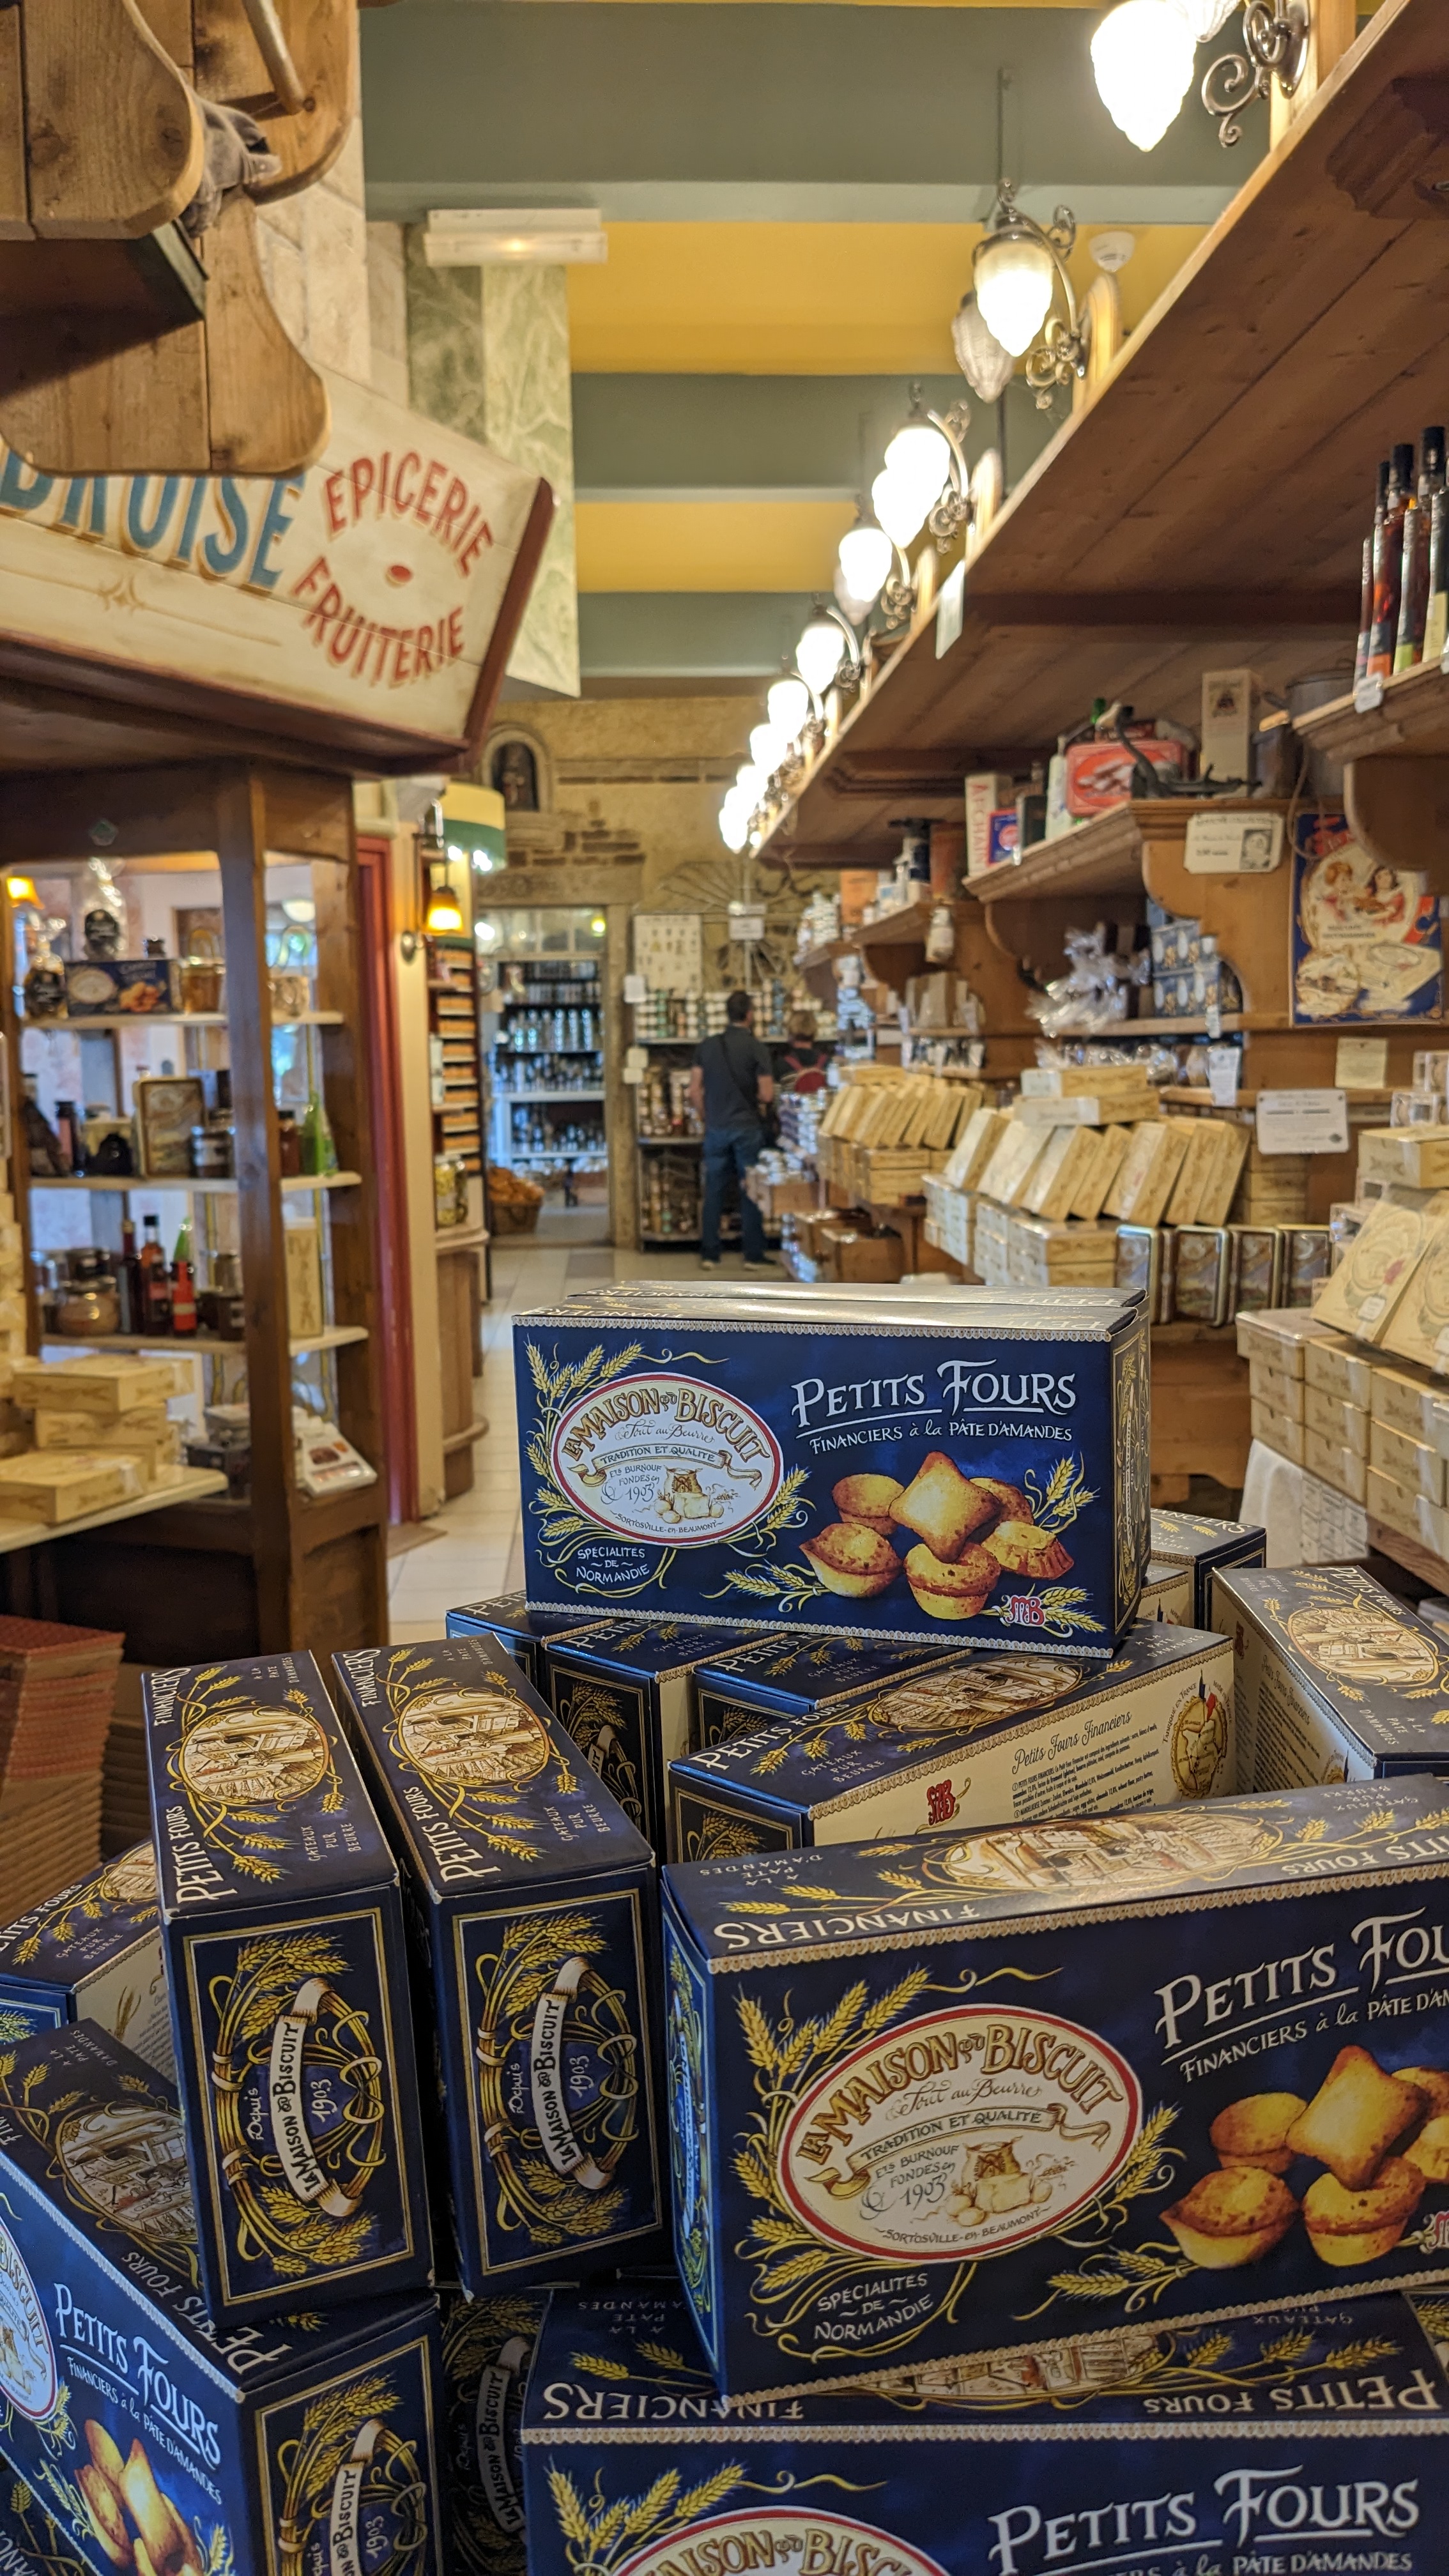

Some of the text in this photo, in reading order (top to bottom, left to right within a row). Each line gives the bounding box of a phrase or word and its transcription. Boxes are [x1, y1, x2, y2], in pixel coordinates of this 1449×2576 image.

[0, 449, 305, 589] OISE
[323, 451, 494, 578] EPICERIE
[292, 556, 464, 686] FRUITERIE
[791, 1359, 1077, 1427] PETITS FOURS
[572, 1388, 661, 1452] MAISON
[675, 1388, 770, 1462] BISCUIT
[809, 1419, 1073, 1455] FINANCIERS à la PÂTE D'AMANDES
[562, 1437, 584, 1461] LA
[601, 1446, 651, 1464] TRADITION
[655, 1446, 668, 1454] ET
[624, 1465, 662, 1474] BURNOUF
[625, 1483, 656, 1504] 1903
[1151, 1508, 1253, 1533] ANCIERS
[578, 1547, 645, 1560] SPÉCIALITÉS
[604, 1560, 619, 1568] DE
[576, 1563, 650, 1584] NORMANDIE
[1317, 1567, 1407, 1616] PETITS FOURS
[710, 1639, 799, 1673] PETITS
[1147, 1637, 1175, 1649] PATE
[267, 1665, 280, 1679] PATE
[342, 1648, 382, 1708] FINANCIERS
[833, 1665, 860, 1676] PUR
[835, 1665, 880, 1683] BEURRE
[151, 1667, 191, 1726] FINANCIERS
[689, 1702, 850, 1770] PETITS FOURS
[1012, 1711, 1132, 1775] Petits Fours Financiers
[1386, 1717, 1409, 1734] PATE
[801, 1749, 862, 1777] GATEAUX
[830, 1760, 861, 1774] PUR
[832, 1759, 885, 1783] BEURRE
[340, 1822, 362, 1853] BEURRE
[403, 1786, 502, 1883] PETITS FOURS
[542, 1806, 580, 1841] GATEAUX
[568, 1812, 586, 1829] PUR
[582, 1803, 611, 1834] BEURRE
[165, 1805, 238, 1904] PETITS FOURS
[301, 1825, 328, 1862] GATEAUX
[326, 1831, 339, 1849] PUR
[699, 1854, 824, 1876] D'AMANDES
[742, 1866, 794, 1881] PATE
[746, 1878, 772, 1886] LA
[1282, 1851, 1380, 1875] FOURS
[0, 1884, 83, 1951] TITS FOURS
[714, 1904, 980, 1949] FINANCIERS
[56, 1928, 103, 1958] GATEAUX
[79, 1938, 103, 1952] PUR
[83, 1933, 123, 1960] BEURRE
[1154, 1906, 1449, 2050] PETITS FOU
[533, 2000, 560, 2072] BISCUIT
[1180, 2020, 1307, 2083] FINANCIERS
[1315, 2012, 1329, 2032] à
[1335, 2003, 1358, 2026] la
[1367, 1994, 1412, 2021] PÂTE
[272, 2021, 299, 2097] BISCUIT
[569, 2055, 595, 2099] 1903
[310, 2078, 338, 2123] 1903
[506, 2062, 530, 2114] Depuis
[795, 2117, 831, 2166] LA
[822, 2031, 960, 2147] MAISON
[979, 2023, 1124, 2114] BISCUIT
[243, 2087, 270, 2140] Depuis
[542, 2089, 575, 2152] MAISON
[284, 2115, 319, 2179] MAISON
[560, 2145, 577, 2166] LA
[860, 2120, 944, 2161] TRADITION
[949, 2113, 972, 2129] ET
[900, 2145, 960, 2168] BURNOUF
[303, 2172, 321, 2193] LA
[900, 2172, 950, 2211] 1903
[122, 2251, 293, 2375] PETS FOURS
[578, 2301, 688, 2310] AMANDES
[612, 2313, 665, 2322] PATE
[813, 2294, 935, 2341] NORMANDIE
[862, 2299, 885, 2315] DE
[54, 2283, 221, 2471] PETITS FOURS
[1143, 2368, 1442, 2414] PETITS FOURS
[479, 2370, 503, 2437] BISCUIT
[542, 2382, 805, 2420] FINANCIERS
[67, 2356, 118, 2404] FINANCIERS
[130, 2397, 140, 2421] la
[144, 2413, 165, 2447] PÂTE
[167, 2438, 222, 2505] D'AMANDES
[488, 2454, 519, 2511] MAISON
[333, 2470, 356, 2547] BISCUIT
[988, 2464, 1419, 2576] PETITS FOURS
[365, 2515, 389, 2559] 1903
[645, 2529, 775, 2576] AISON
[799, 2528, 914, 2576] BISC
[1233, 2554, 1291, 2575] PÂTE
[1291, 2552, 1413, 2573] D'AMANDES
